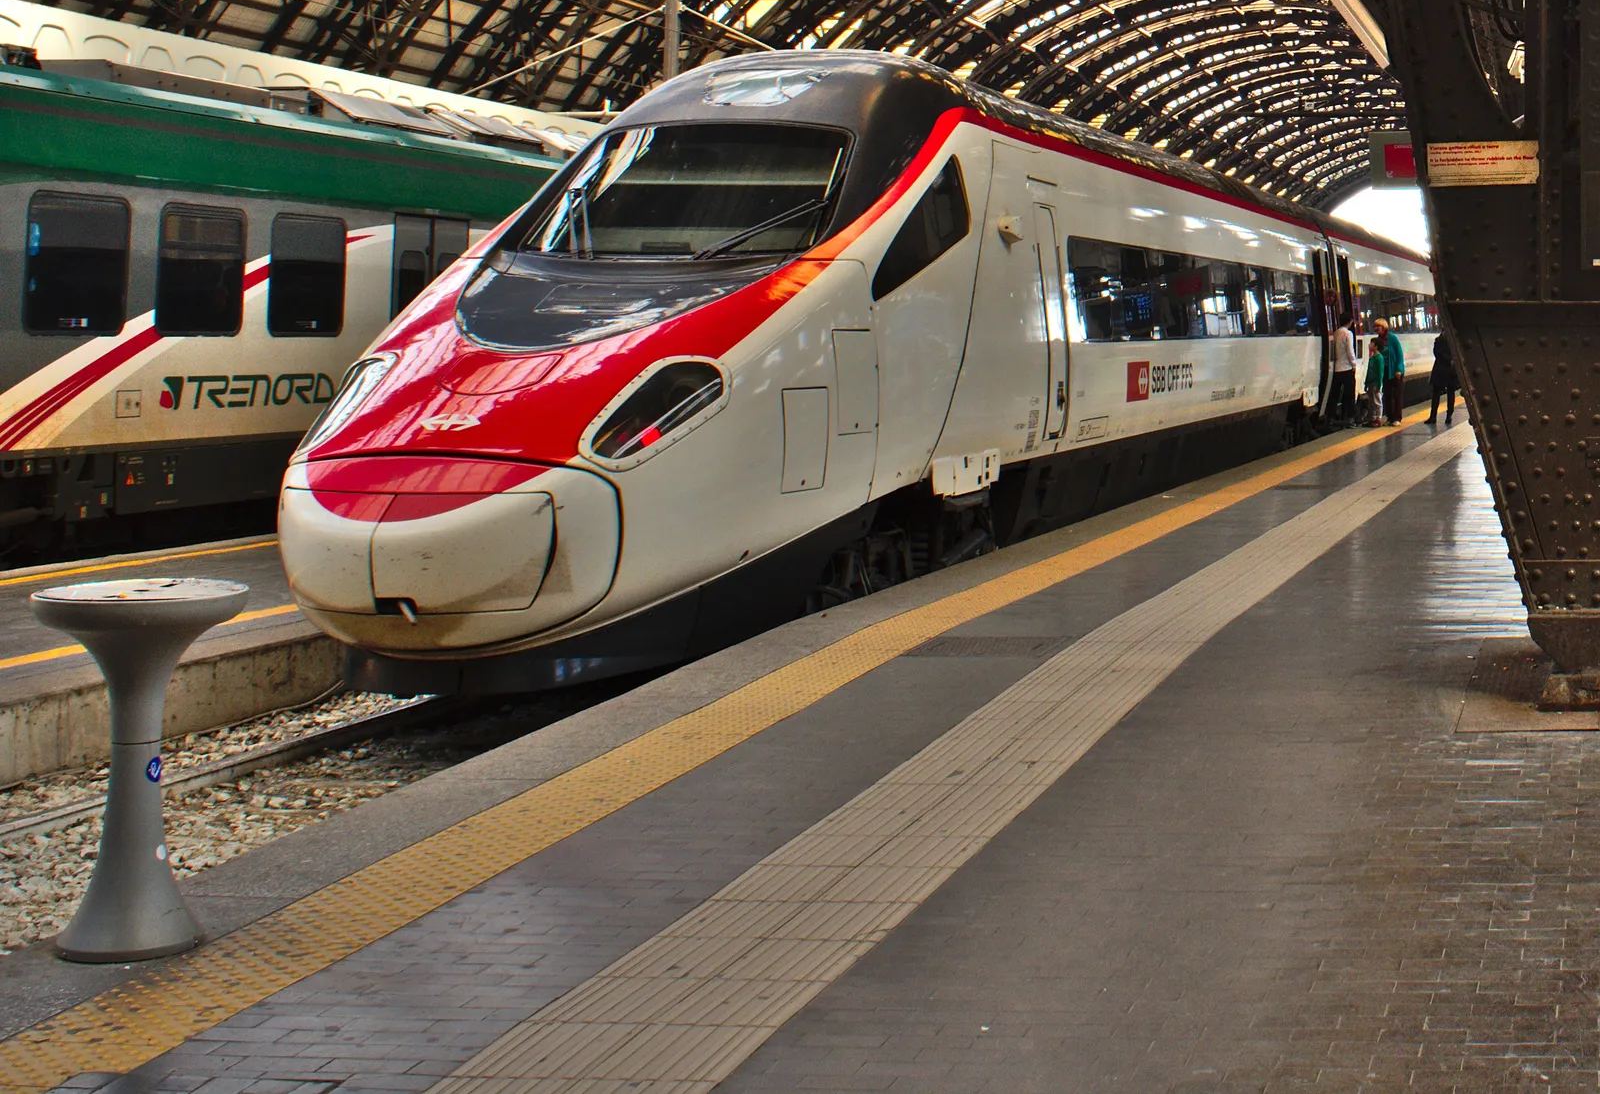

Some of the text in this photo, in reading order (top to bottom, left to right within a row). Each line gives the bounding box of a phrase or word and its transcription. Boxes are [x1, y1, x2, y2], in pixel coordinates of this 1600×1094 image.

[186, 372, 335, 410] TRENORD
[1152, 362, 1193, 393] SBB CFF FFS
